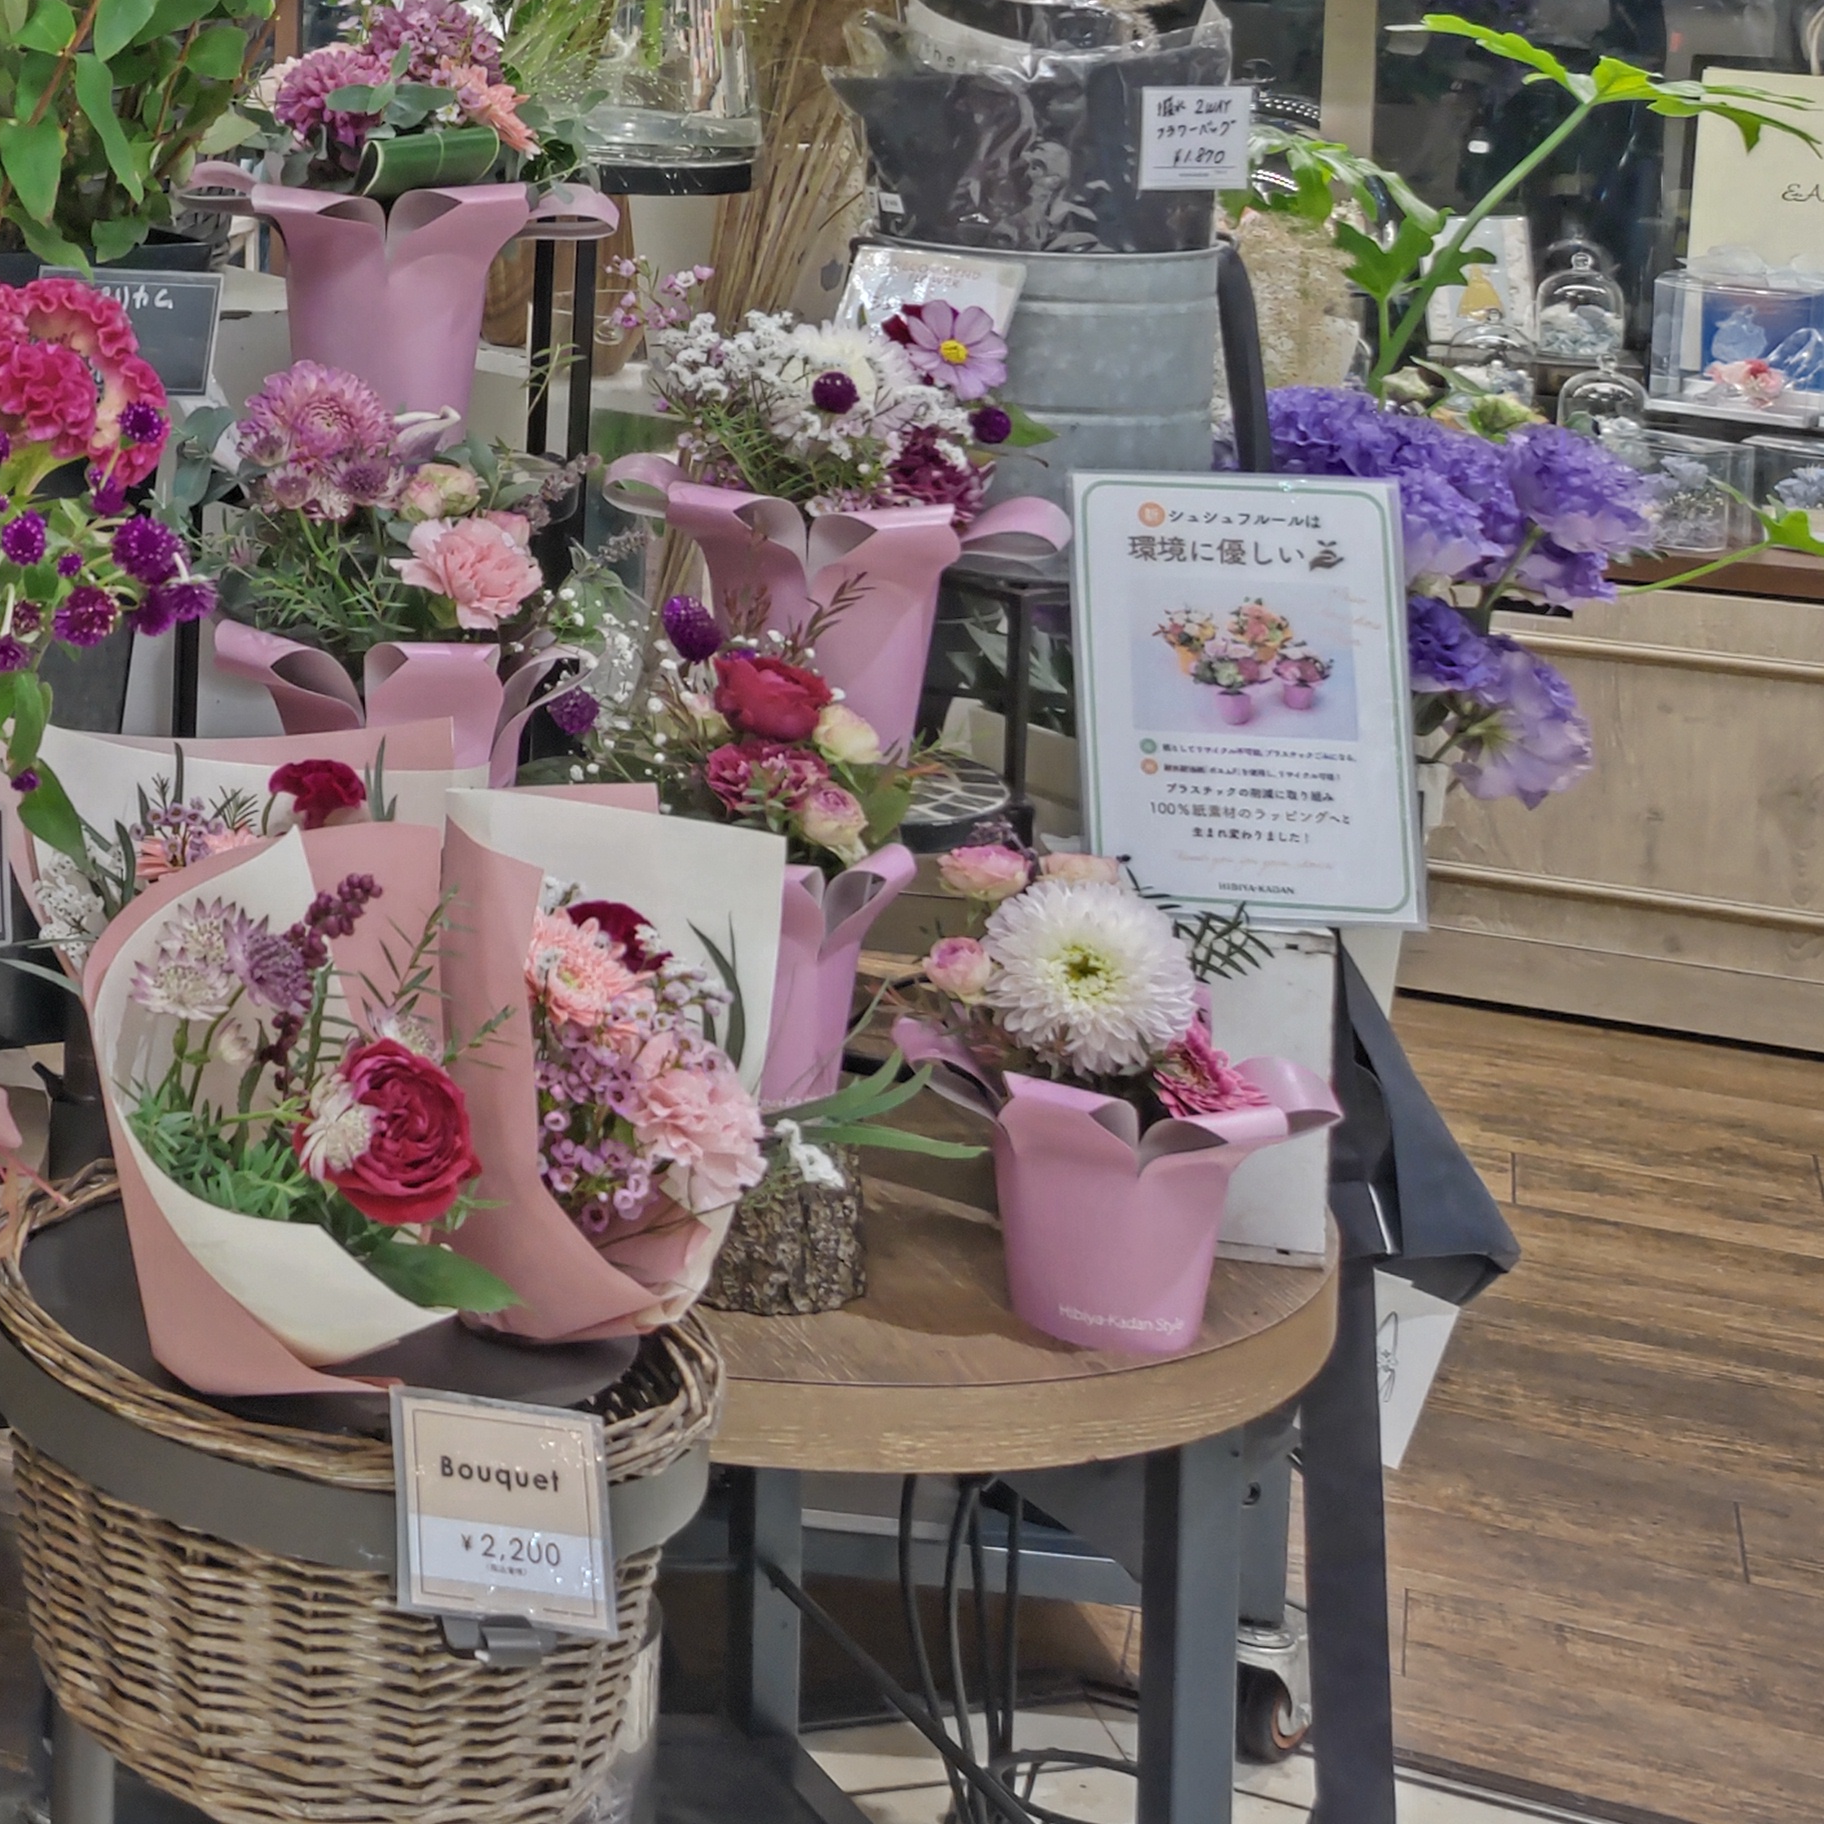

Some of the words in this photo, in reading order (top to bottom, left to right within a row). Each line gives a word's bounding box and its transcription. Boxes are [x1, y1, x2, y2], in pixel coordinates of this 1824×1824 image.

[1168, 509, 1322, 529] シュシュフルールは
[1127, 534, 1306, 567] 環境に優しい
[1166, 782, 1335, 803] プラスチックの削減に取り組み
[440, 1454, 560, 1493] Bouquet
[461, 1533, 561, 1567] ¥2,200
